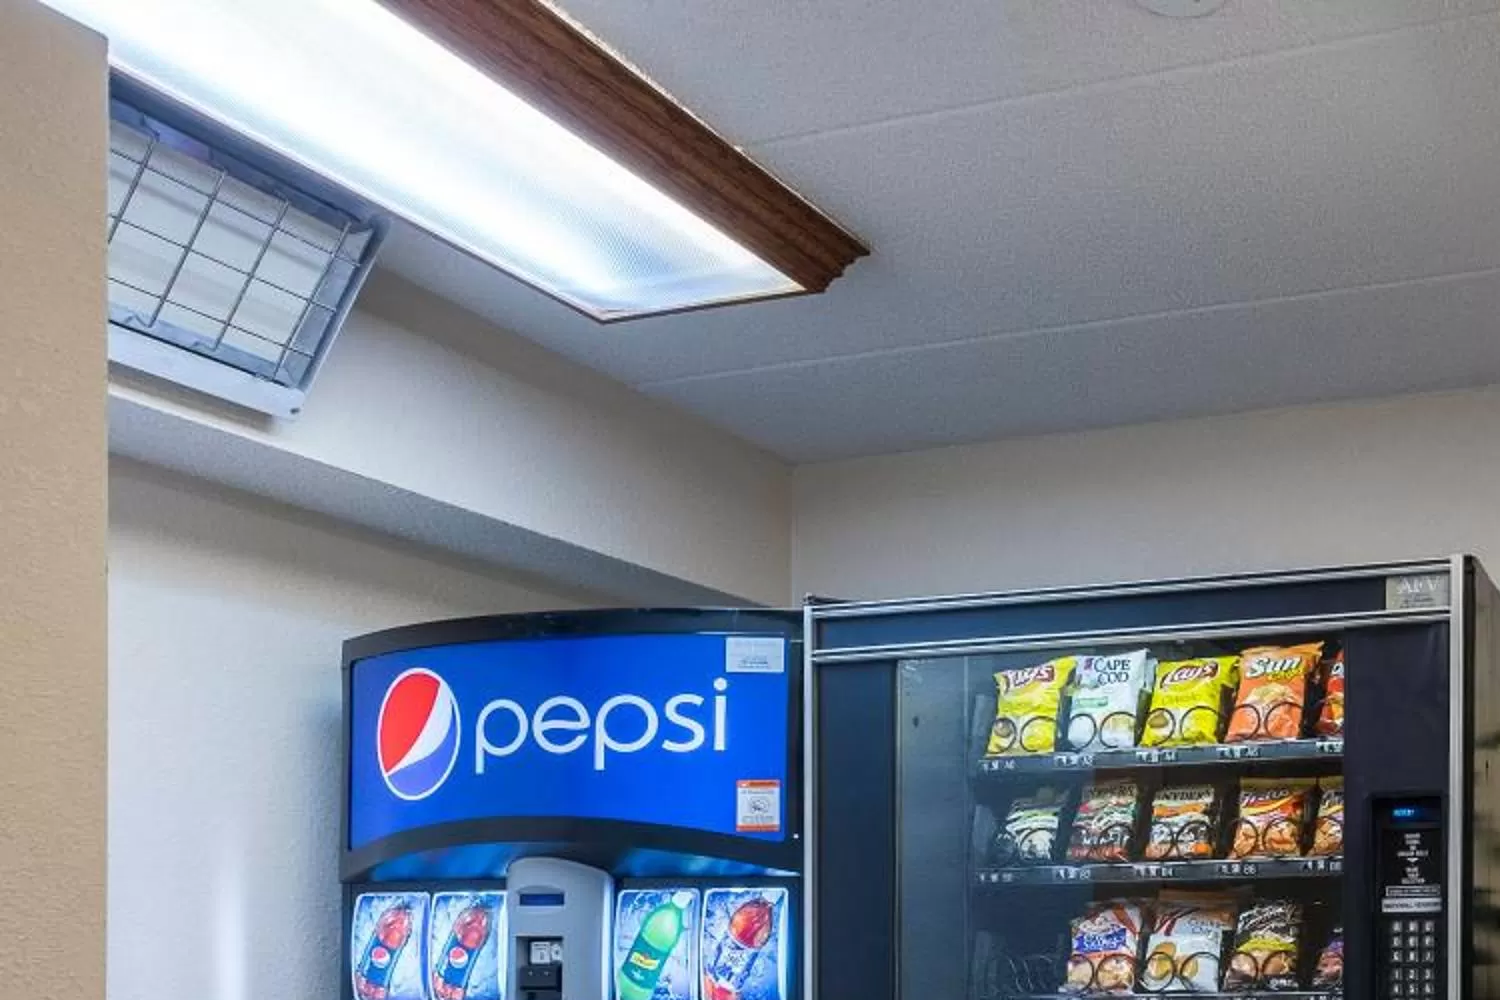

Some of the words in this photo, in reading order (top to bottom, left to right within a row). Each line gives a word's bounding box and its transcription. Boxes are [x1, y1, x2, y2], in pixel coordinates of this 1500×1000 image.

[1093, 657, 1131, 673] CAPE
[1245, 655, 1302, 678] Sun
[1098, 672, 1130, 686] COD
[475, 676, 729, 775] pepsi
